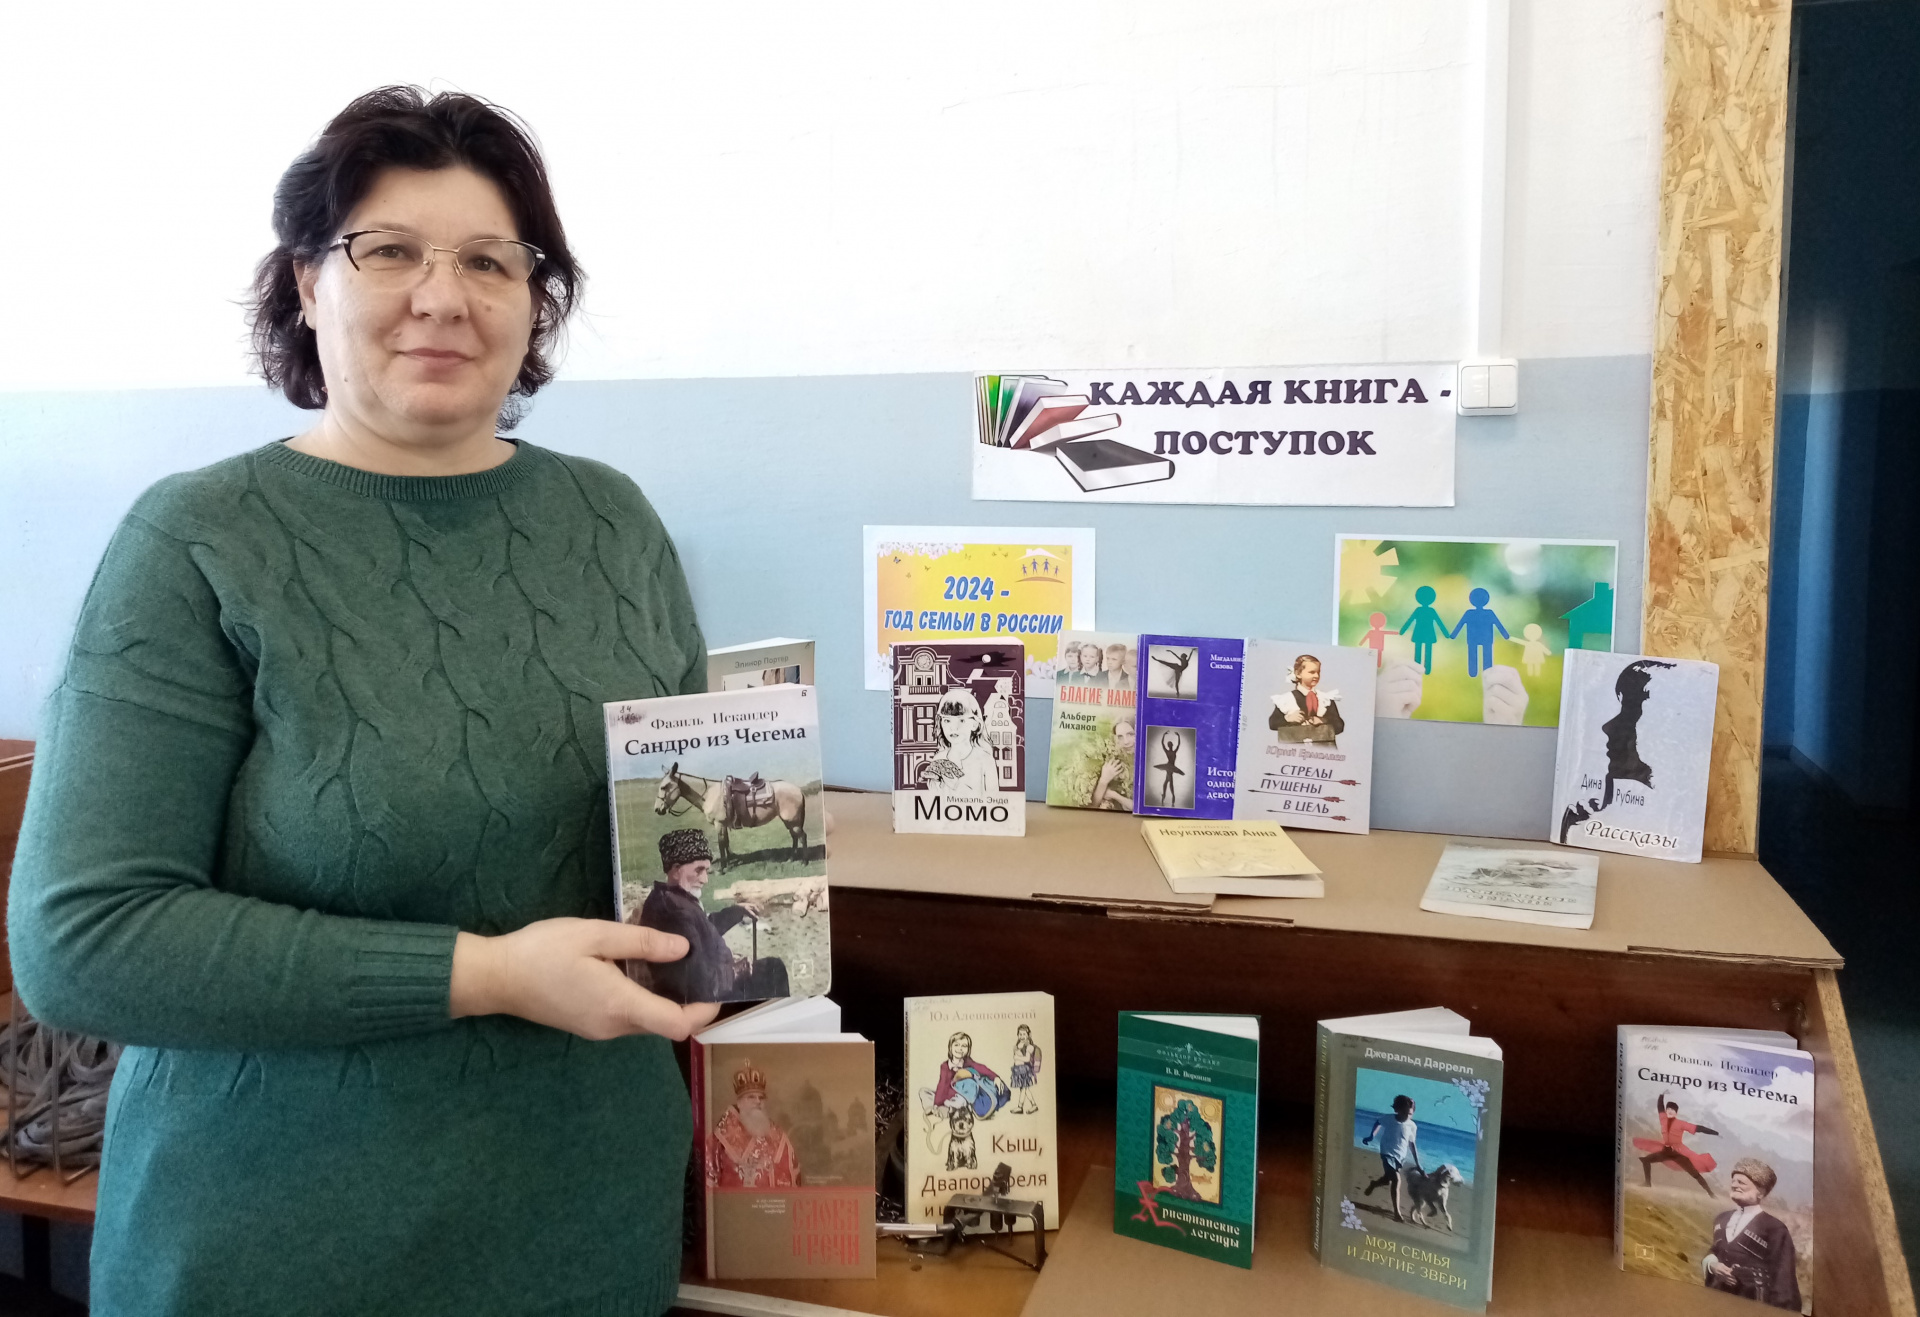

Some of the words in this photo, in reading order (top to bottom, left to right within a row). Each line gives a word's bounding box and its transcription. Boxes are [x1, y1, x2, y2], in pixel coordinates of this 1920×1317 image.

[1089, 380, 1272, 408] КАЖДАЯ
[1284, 378, 1429, 405] КНИГА
[1154, 430, 1377, 456] ПОСТУПОК
[943, 576, 994, 601] 2024
[884, 610, 914, 631] ГОД
[919, 611, 975, 632] СЕМЬИ
[980, 613, 991, 632] В
[996, 613, 1064, 634] РОССИИ
[1210, 661, 1234, 670] Сизова
[1060, 685, 1103, 704] БЛАГИЕ
[650, 716, 704, 730] Фазиль
[713, 711, 779, 724] Искандер
[1059, 721, 1097, 732] Лиханов
[1060, 711, 1097, 723] Альберт
[624, 735, 701, 756] Сандро
[706, 733, 730, 747] из
[733, 727, 807, 744] Чегема
[1266, 745, 1297, 758] Юрий
[1298, 748, 1346, 761] Ермолаев
[1280, 764, 1333, 779] СТРЕЛЫ
[1580, 774, 1602, 790] Дина
[946, 795, 984, 804] Михаэль
[986, 796, 1009, 804] Энде
[1283, 800, 1292, 810] В
[1295, 800, 1330, 814] ЦЕЛЬ
[1616, 788, 1645, 806] Рубина
[914, 795, 1009, 822] Момо
[1158, 828, 1238, 838] Неуклюжая
[1242, 829, 1278, 838] Анна
[1585, 820, 1679, 849] Рассказы
[952, 1008, 1036, 1021] Алешковский
[1364, 1047, 1422, 1067] Джеральд
[1423, 1057, 1474, 1075] Даррелл
[1668, 1052, 1713, 1067] Фазиль
[1720, 1060, 1779, 1080] Искандер
[1637, 1067, 1702, 1090] Сандро
[1708, 1080, 1728, 1092] из
[1733, 1081, 1799, 1105] Чегема
[992, 1134, 1043, 1156] Кыш,
[921, 1173, 1048, 1197] Двапореля
[1190, 1227, 1240, 1248] легенды
[1364, 1234, 1396, 1253] МОЯ
[1401, 1245, 1451, 1269] СЕМЬЯ
[1347, 1244, 1357, 1257] И
[1360, 1249, 1416, 1274] ДРУГИЕ
[1420, 1266, 1468, 1290] ЗВЕРИ
